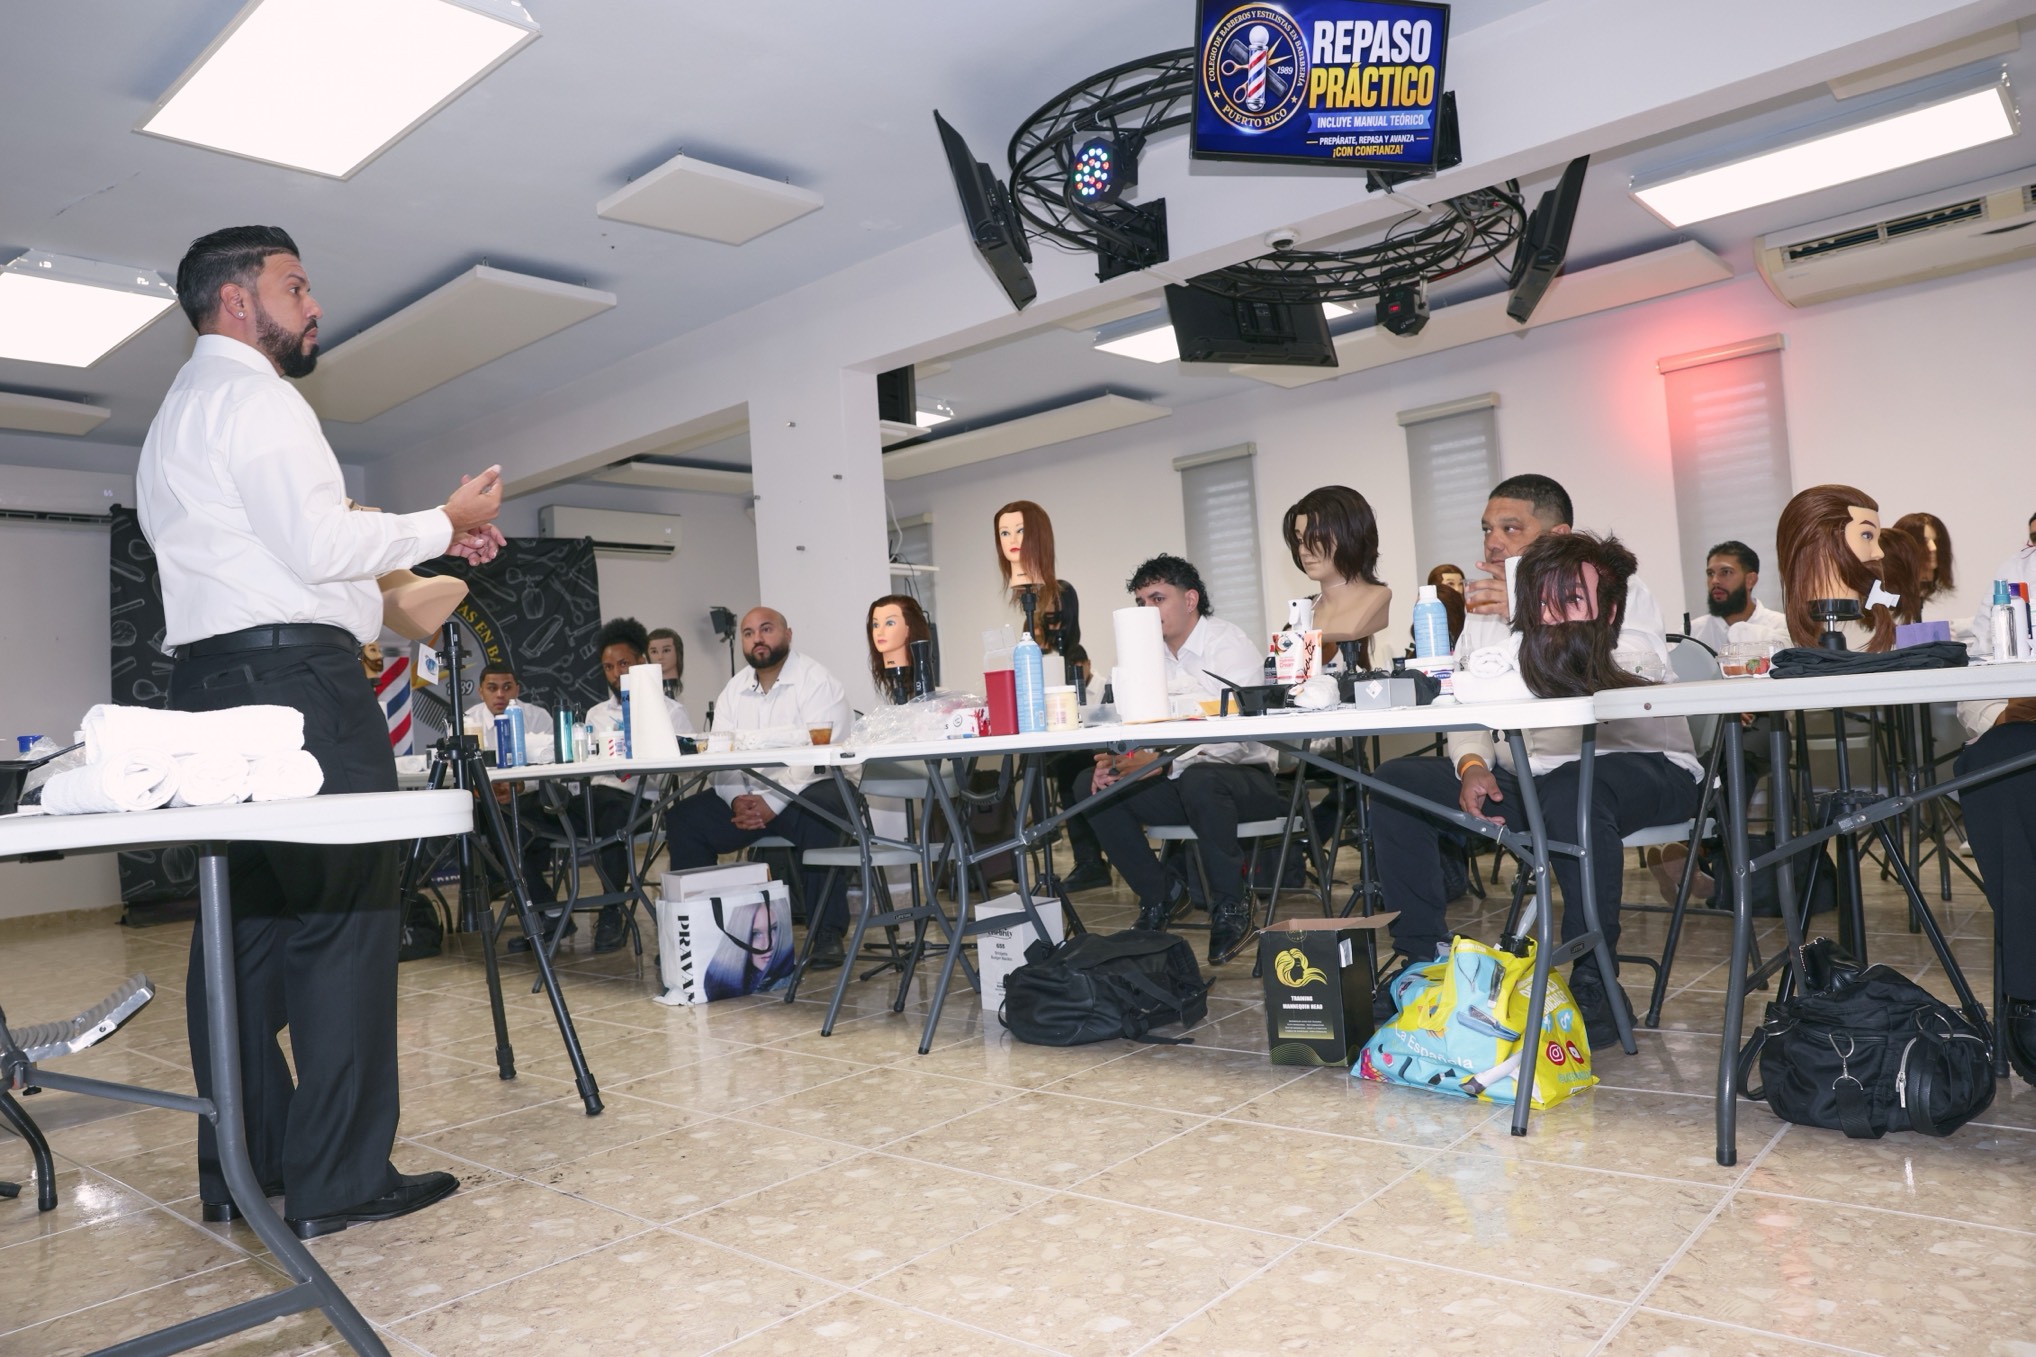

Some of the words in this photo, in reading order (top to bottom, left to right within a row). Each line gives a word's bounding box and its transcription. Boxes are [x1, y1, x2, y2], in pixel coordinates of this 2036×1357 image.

[1208, 46, 1218, 82] COLEGIO
[1214, 35, 1223, 47] DE
[1220, 11, 1251, 38] BARBEROS
[1250, 10, 1257, 18] Y
[1257, 10, 1292, 32] ESTILISTAS
[1289, 28, 1299, 41] EN
[1312, 19, 1432, 64] REPASO
[1276, 66, 1294, 75] 1989
[1309, 62, 1435, 109] PRÁCTICO
[1222, 104, 1262, 128] PUERTO
[1263, 108, 1287, 126] RICO
[1317, 116, 1352, 128] INCLUYE
[1353, 115, 1388, 127] MANUAL
[1390, 113, 1424, 126] TEÓRICO
[1319, 135, 1358, 145] PREPÁRATE,
[1358, 135, 1384, 144] REPASA
[1384, 135, 1389, 143] Y
[1389, 134, 1415, 143] AVANZA
[1332, 147, 1353, 158] ¡CON
[1354, 145, 1404, 156] CONFIANZA!
[474, 620, 495, 644] EN
[1395, 1022, 1407, 1042] La
